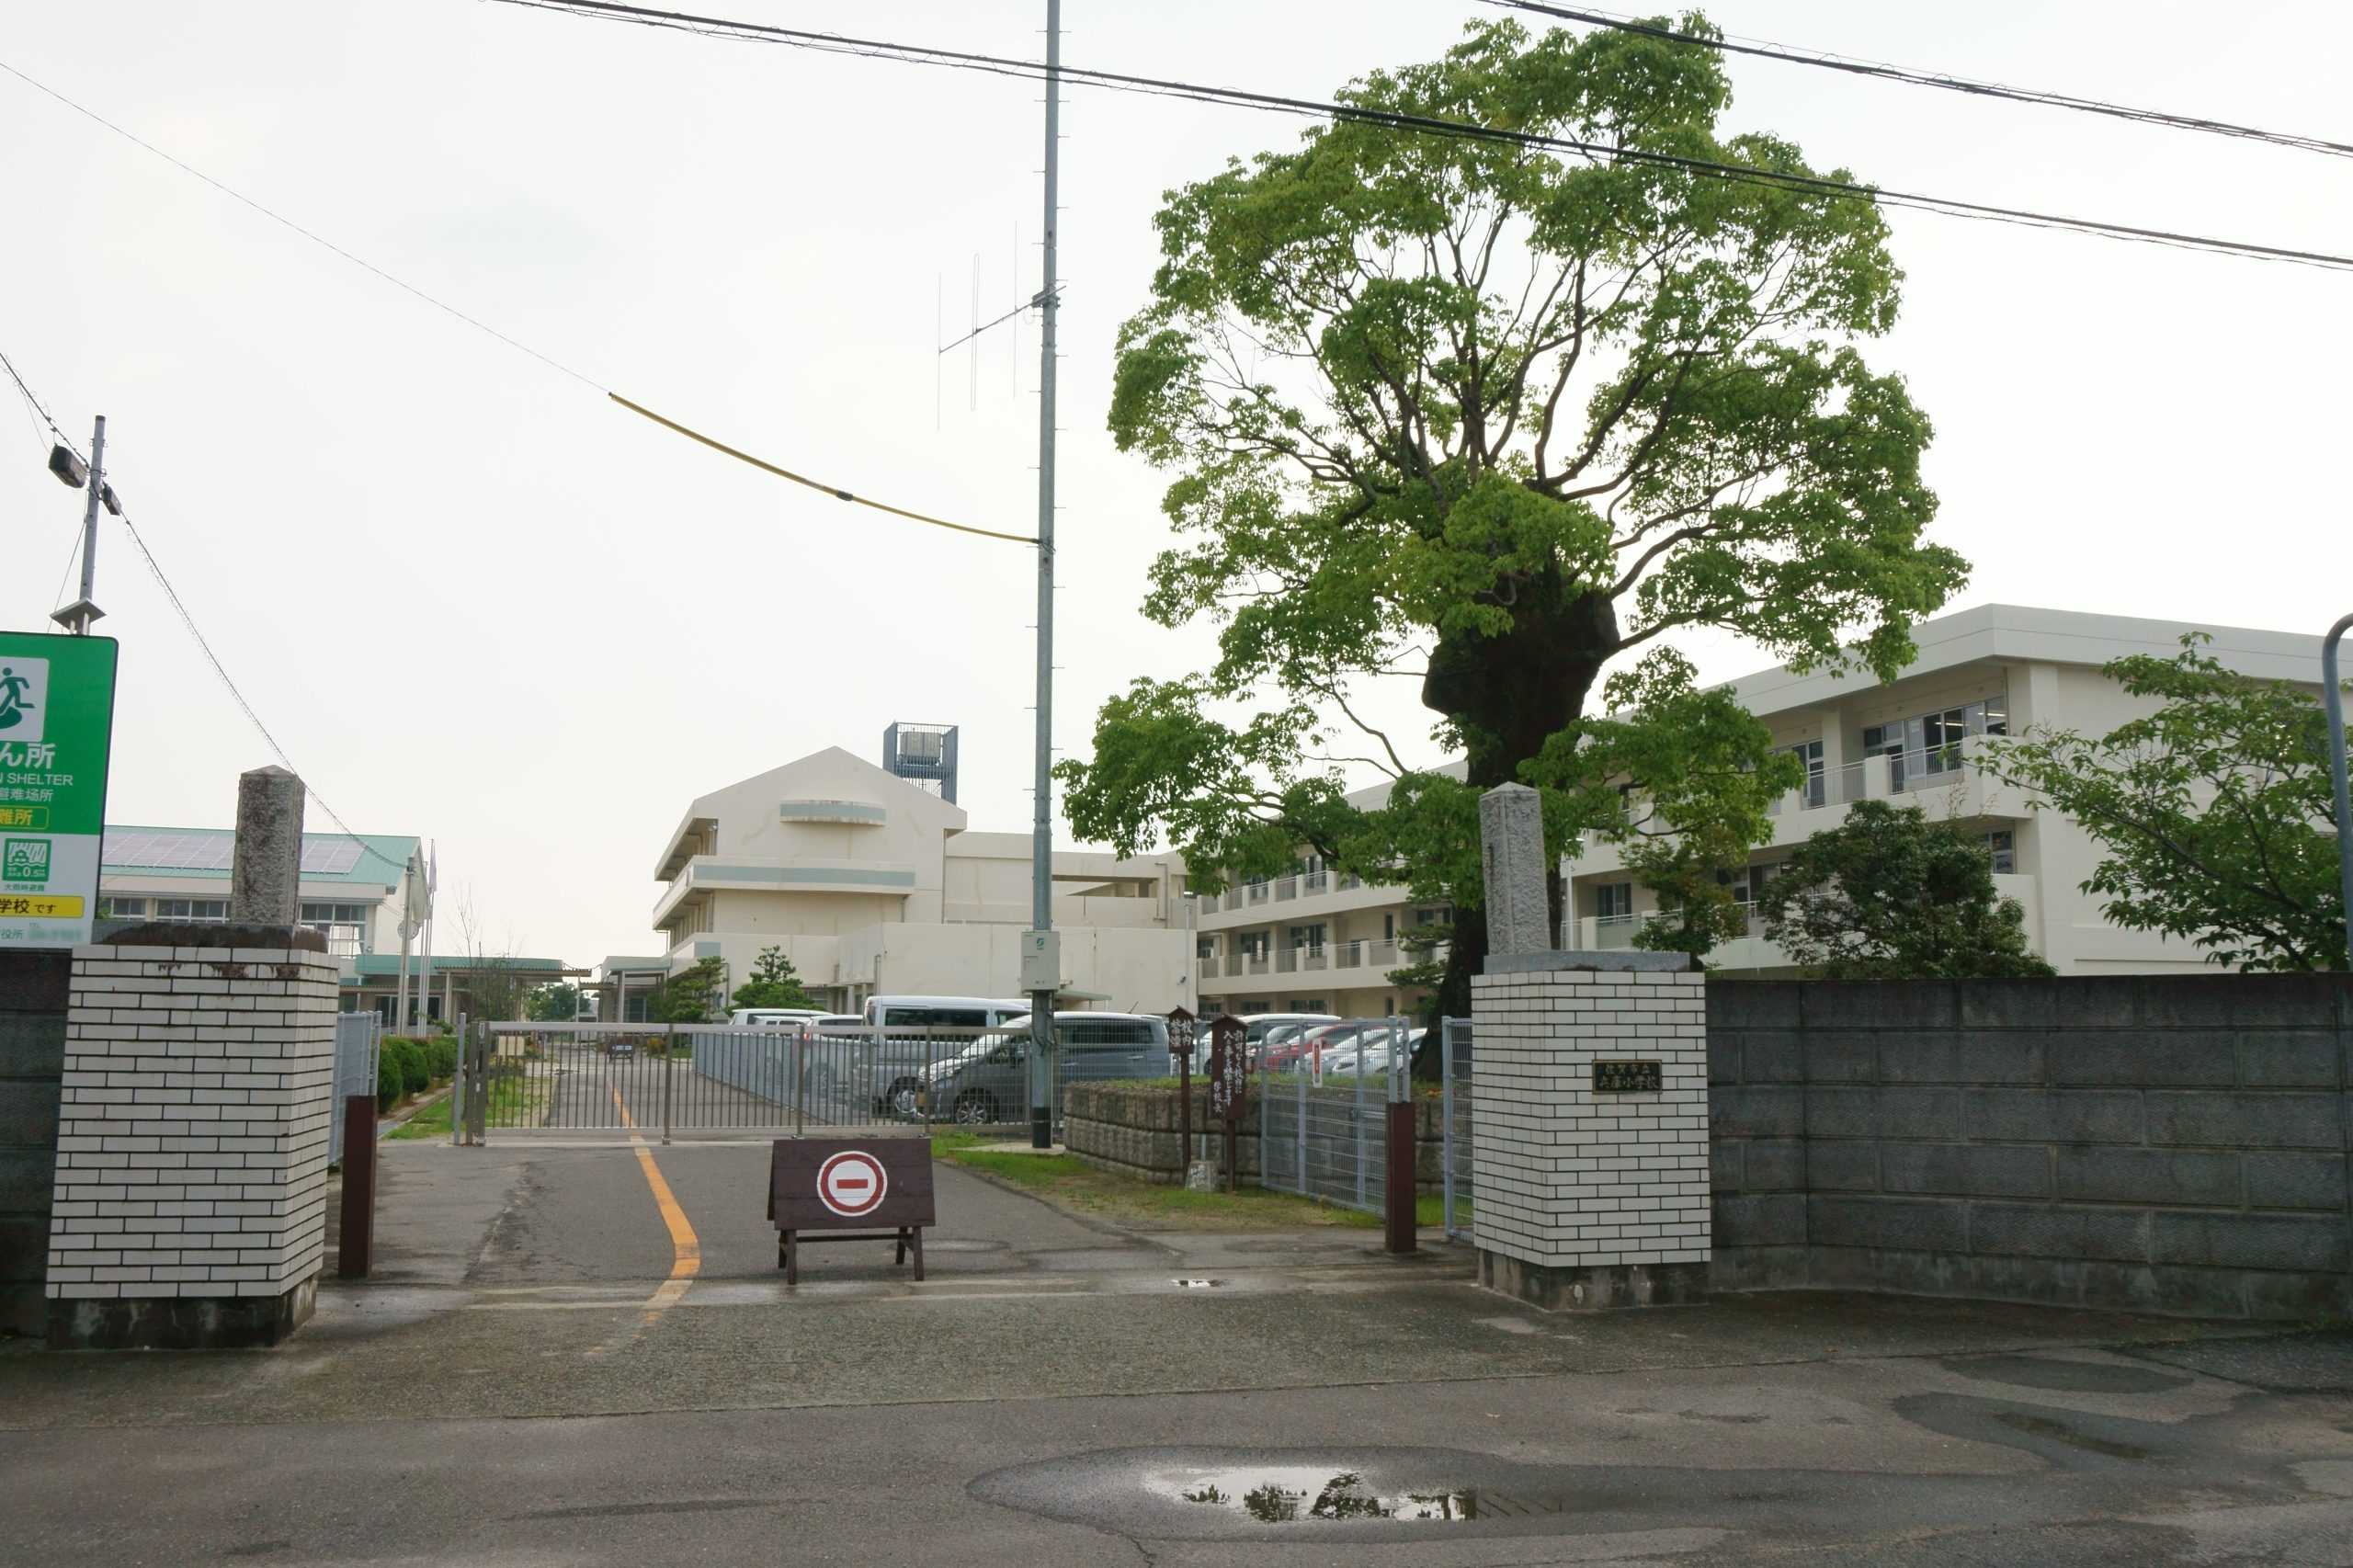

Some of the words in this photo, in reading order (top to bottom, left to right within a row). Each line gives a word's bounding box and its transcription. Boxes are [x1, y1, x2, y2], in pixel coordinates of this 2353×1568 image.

[0, 742, 56, 770] ん所
[7, 773, 74, 786] SHELTER
[0, 899, 29, 914] 学校
[34, 903, 56, 914] です
